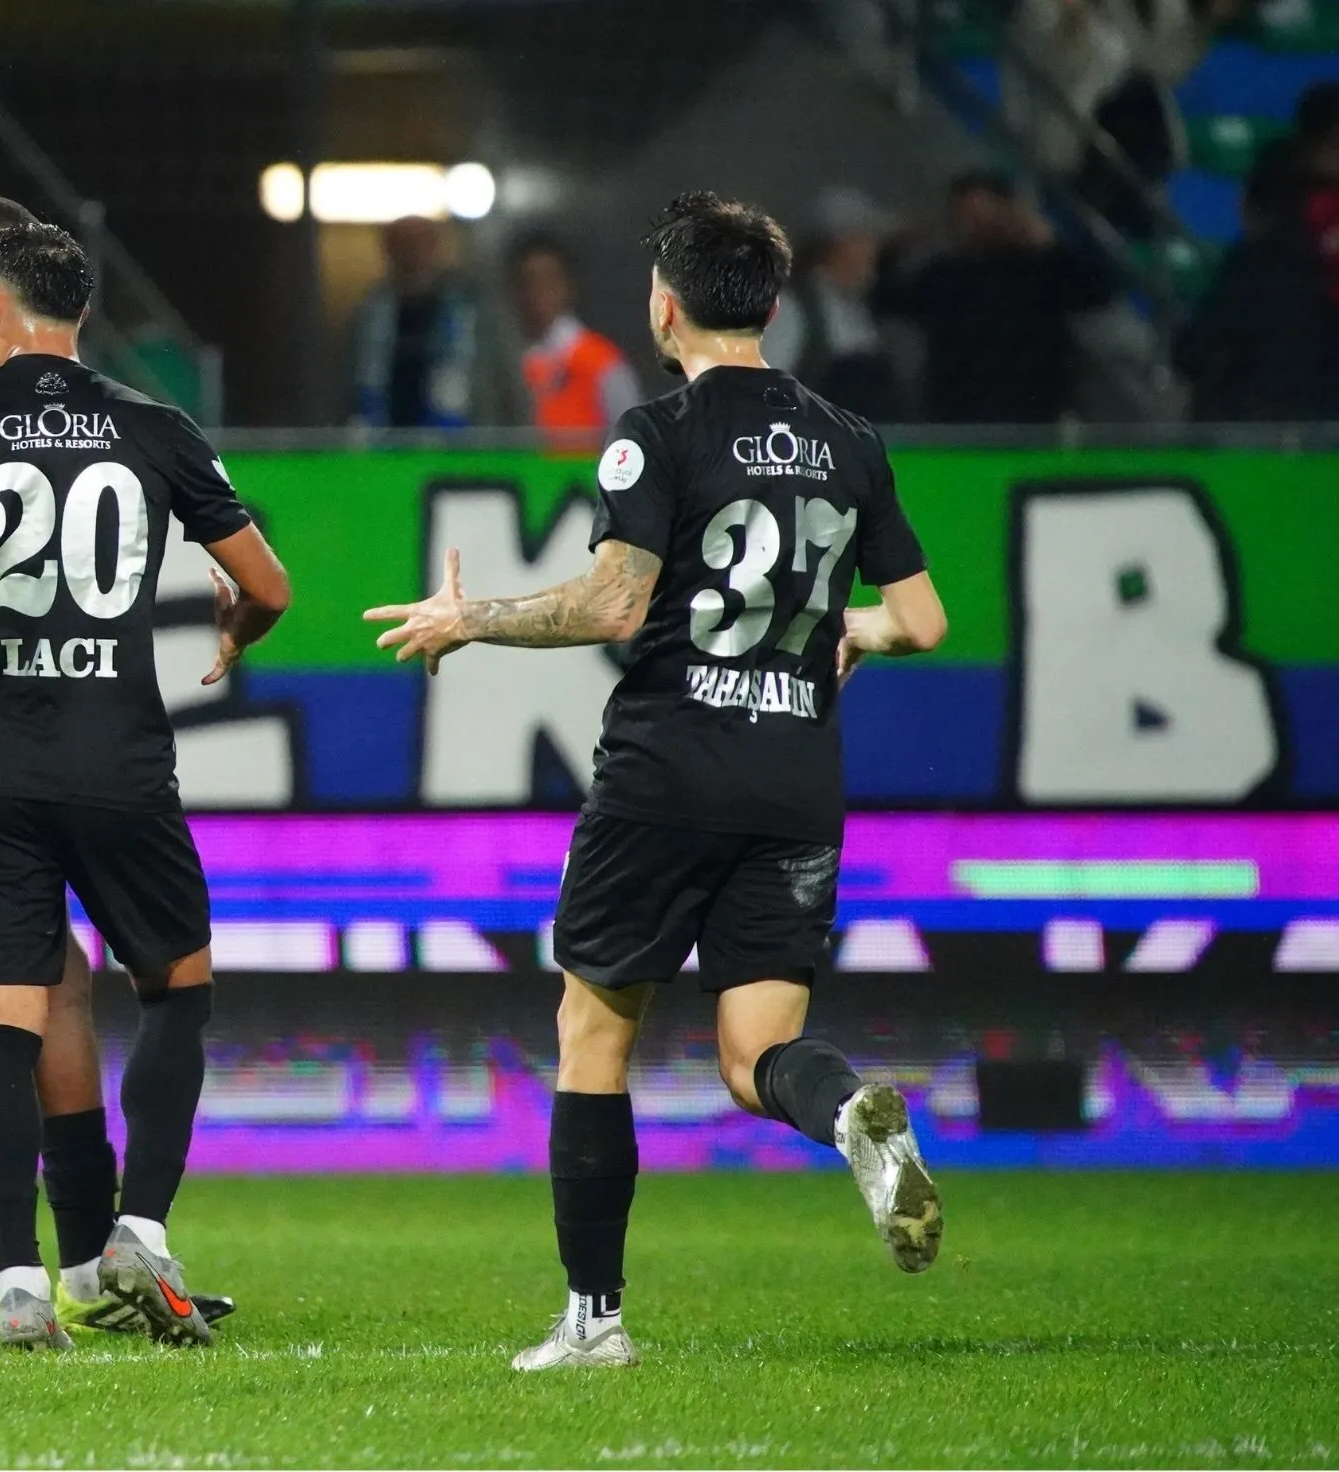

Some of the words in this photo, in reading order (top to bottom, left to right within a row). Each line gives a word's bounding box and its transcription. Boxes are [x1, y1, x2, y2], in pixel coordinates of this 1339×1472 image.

[0, 407, 121, 440] GLORIA
[11, 438, 53, 451] HOTELS
[54, 438, 63, 448] &
[65, 439, 111, 450] RESORTS
[733, 430, 837, 470] GLORIA
[747, 465, 783, 476] HOTELS
[785, 464, 795, 475] &
[795, 465, 828, 481] RORTS
[690, 495, 858, 657] 37
[1, 638, 118, 678] LACI
